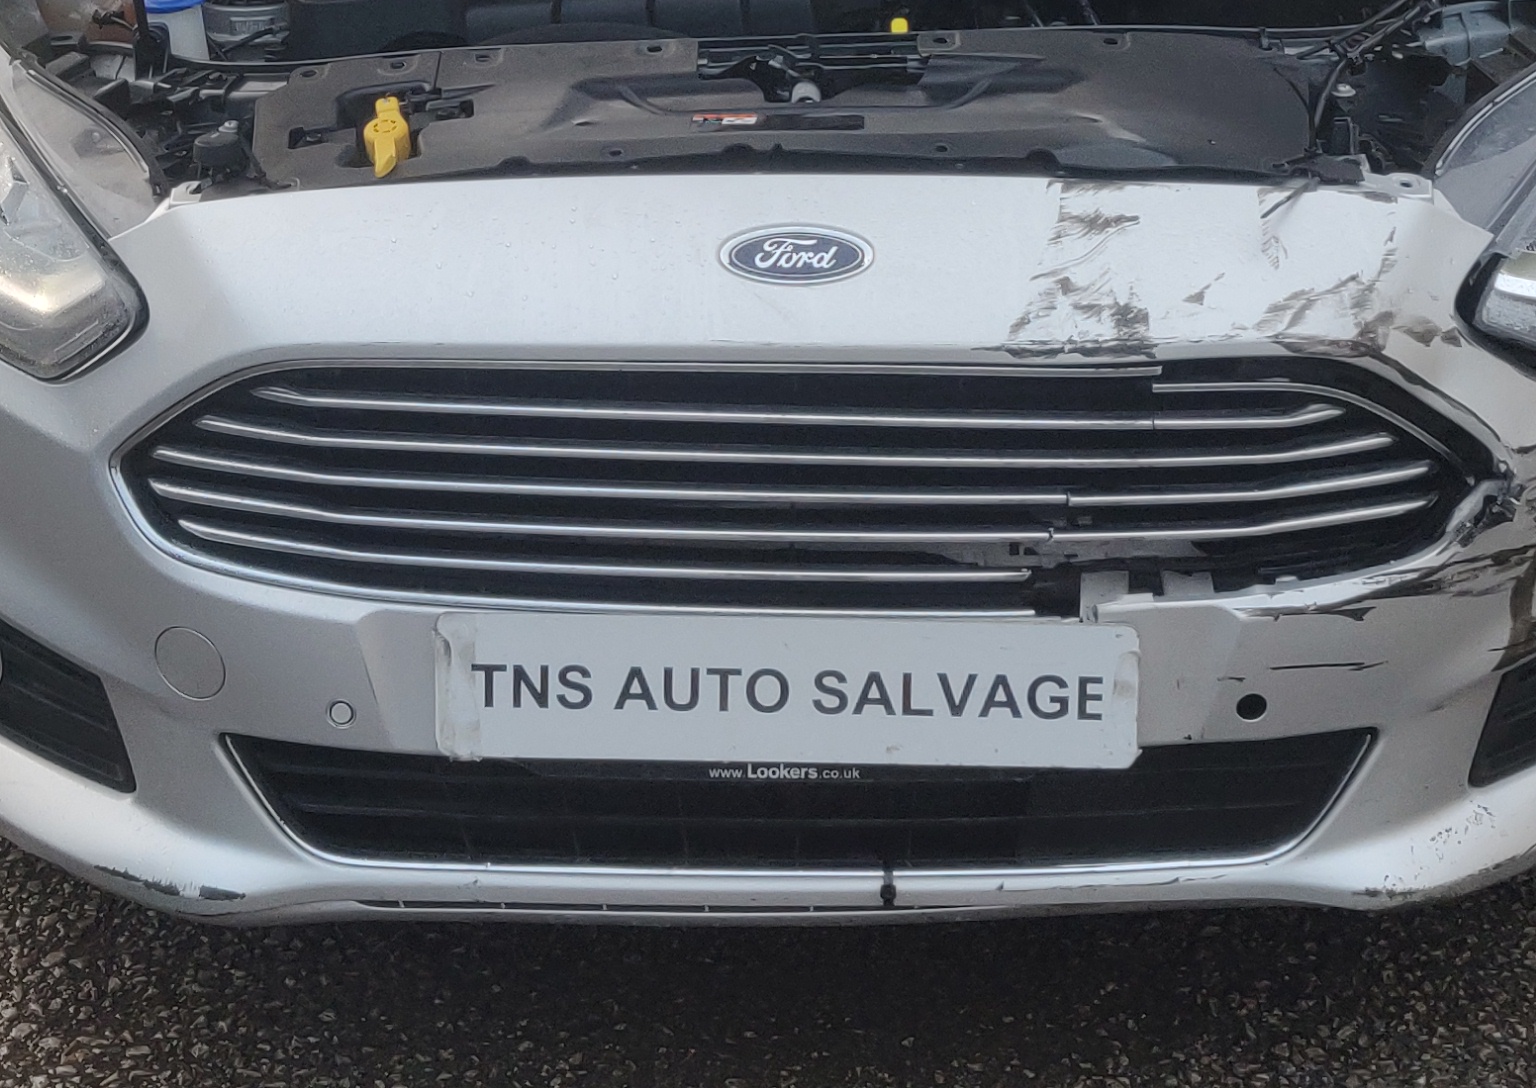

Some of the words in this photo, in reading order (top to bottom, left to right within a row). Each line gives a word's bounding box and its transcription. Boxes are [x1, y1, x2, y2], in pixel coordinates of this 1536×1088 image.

[754, 237, 839, 269] Ford
[471, 663, 593, 710] TNS
[613, 666, 790, 714] AUTO
[812, 669, 1104, 721] SALVAGE
